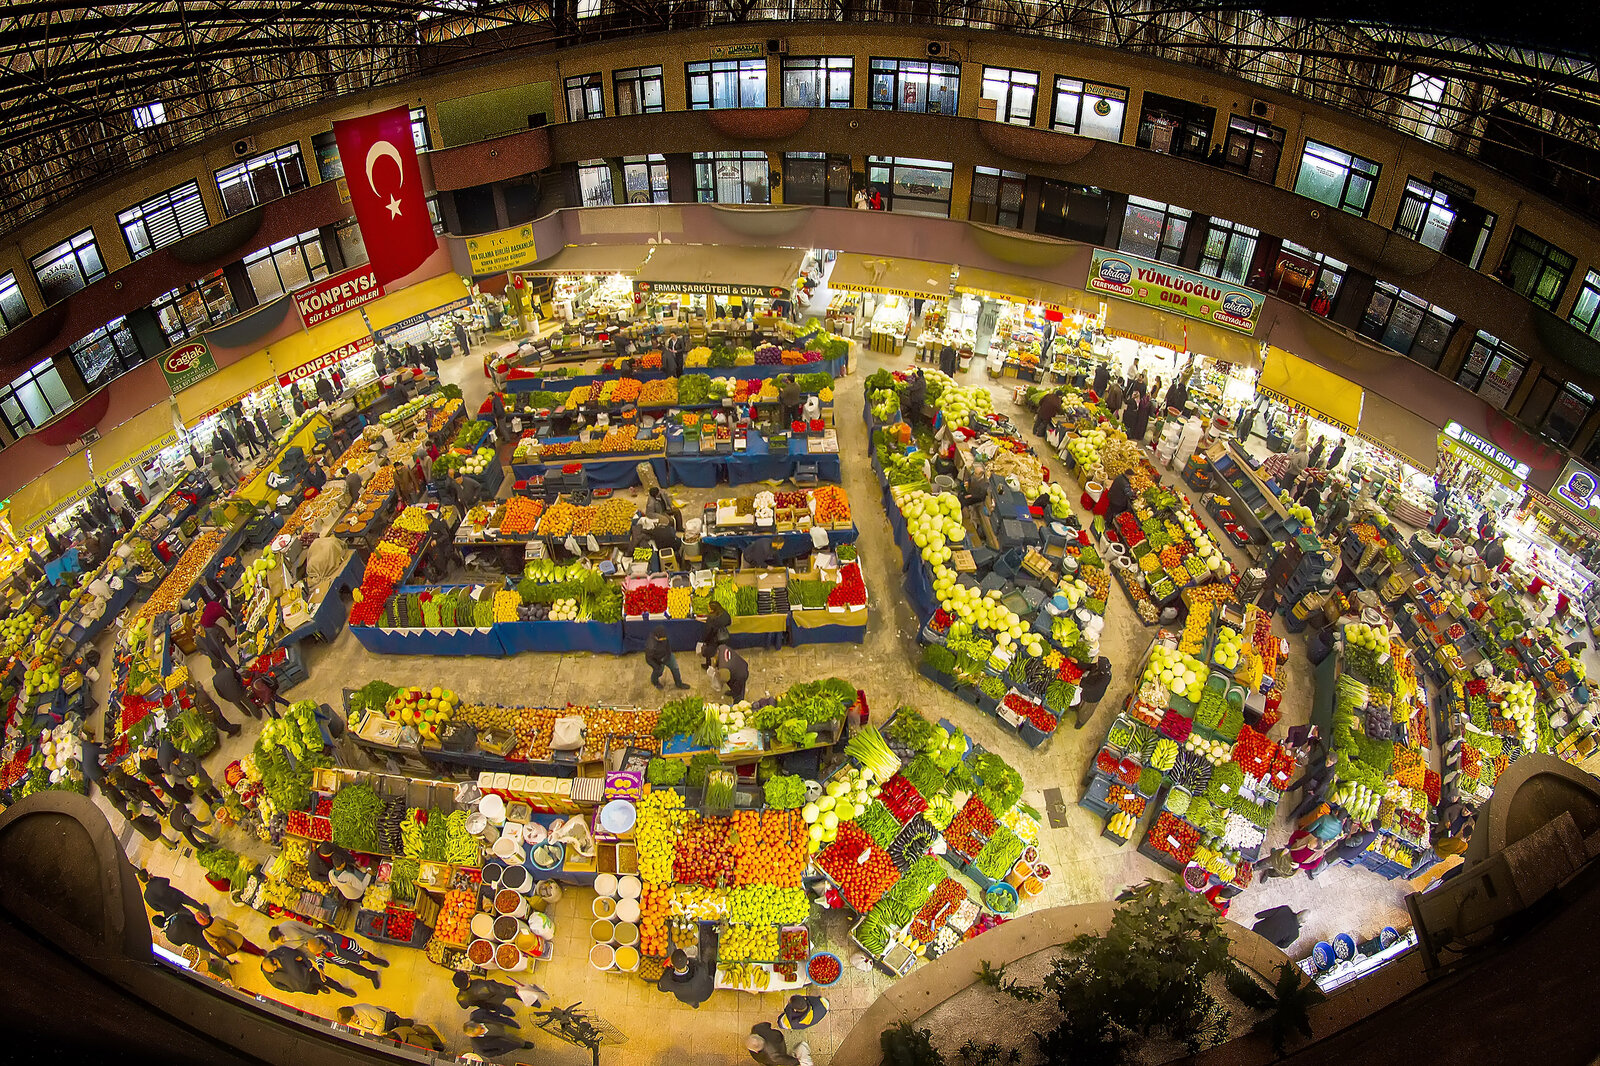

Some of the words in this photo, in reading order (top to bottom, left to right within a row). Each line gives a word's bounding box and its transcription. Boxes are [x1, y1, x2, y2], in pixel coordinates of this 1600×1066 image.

[299, 272, 377, 316] KONPEYSA
[654, 284, 682, 292] ERMAN
[682, 284, 731, 295] ŞARKÜTERİ
[740, 287, 764, 296] GIDA
[914, 292, 946, 302] PAZARI
[1137, 268, 1222, 301] YÜNLÜOĞLU
[1160, 291, 1188, 307] GIDA
[309, 313, 323, 324] SÜT
[324, 309, 330, 318] &
[331, 302, 345, 315] SÜT
[345, 288, 379, 309] ÜRÜNLERİ
[168, 345, 204, 371] Çağlak
[287, 344, 358, 382] KONPEYSA
[1260, 387, 1289, 405] KONYA
[1294, 403, 1311, 415] BAL
[1317, 414, 1350, 433] PAZARI
